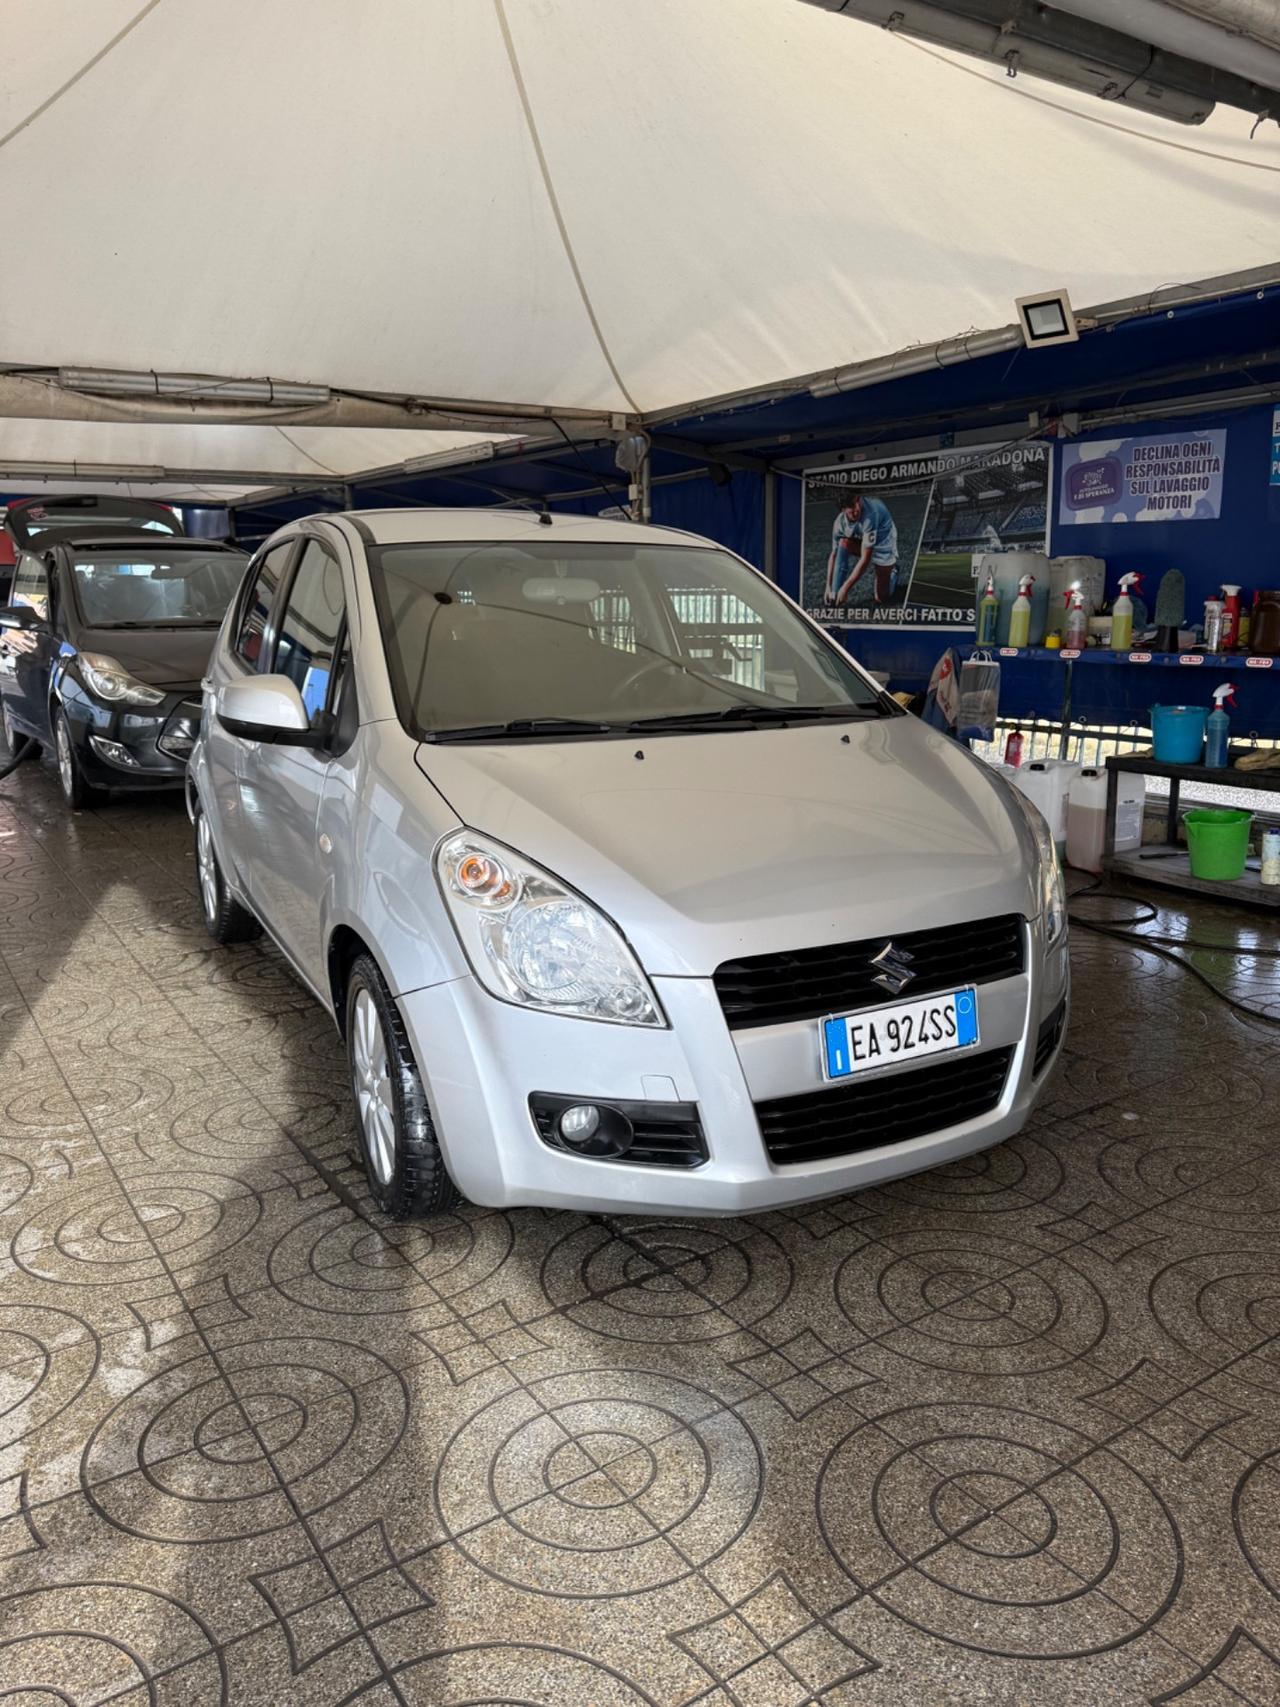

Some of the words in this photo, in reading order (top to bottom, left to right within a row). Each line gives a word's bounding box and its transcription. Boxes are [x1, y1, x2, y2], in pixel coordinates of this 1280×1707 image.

[1133, 444, 1180, 461] DECLINA
[1182, 441, 1212, 458] OGNI
[808, 472, 848, 489] STADIO
[851, 466, 888, 484] DIEGO
[890, 456, 955, 478] ARMANDO
[1125, 456, 1221, 479] RESPONSABILITÀ
[1130, 481, 1150, 495] SUL
[1153, 476, 1210, 493] LAVAGGIO
[1147, 494, 1193, 511] MOTORI
[806, 608, 845, 620] GRAZIE
[847, 608, 870, 620] PER
[872, 608, 919, 621] AVERCI
[921, 609, 962, 622] FATTO
[851, 1022, 881, 1061] EA
[887, 1005, 957, 1053] 924SS
